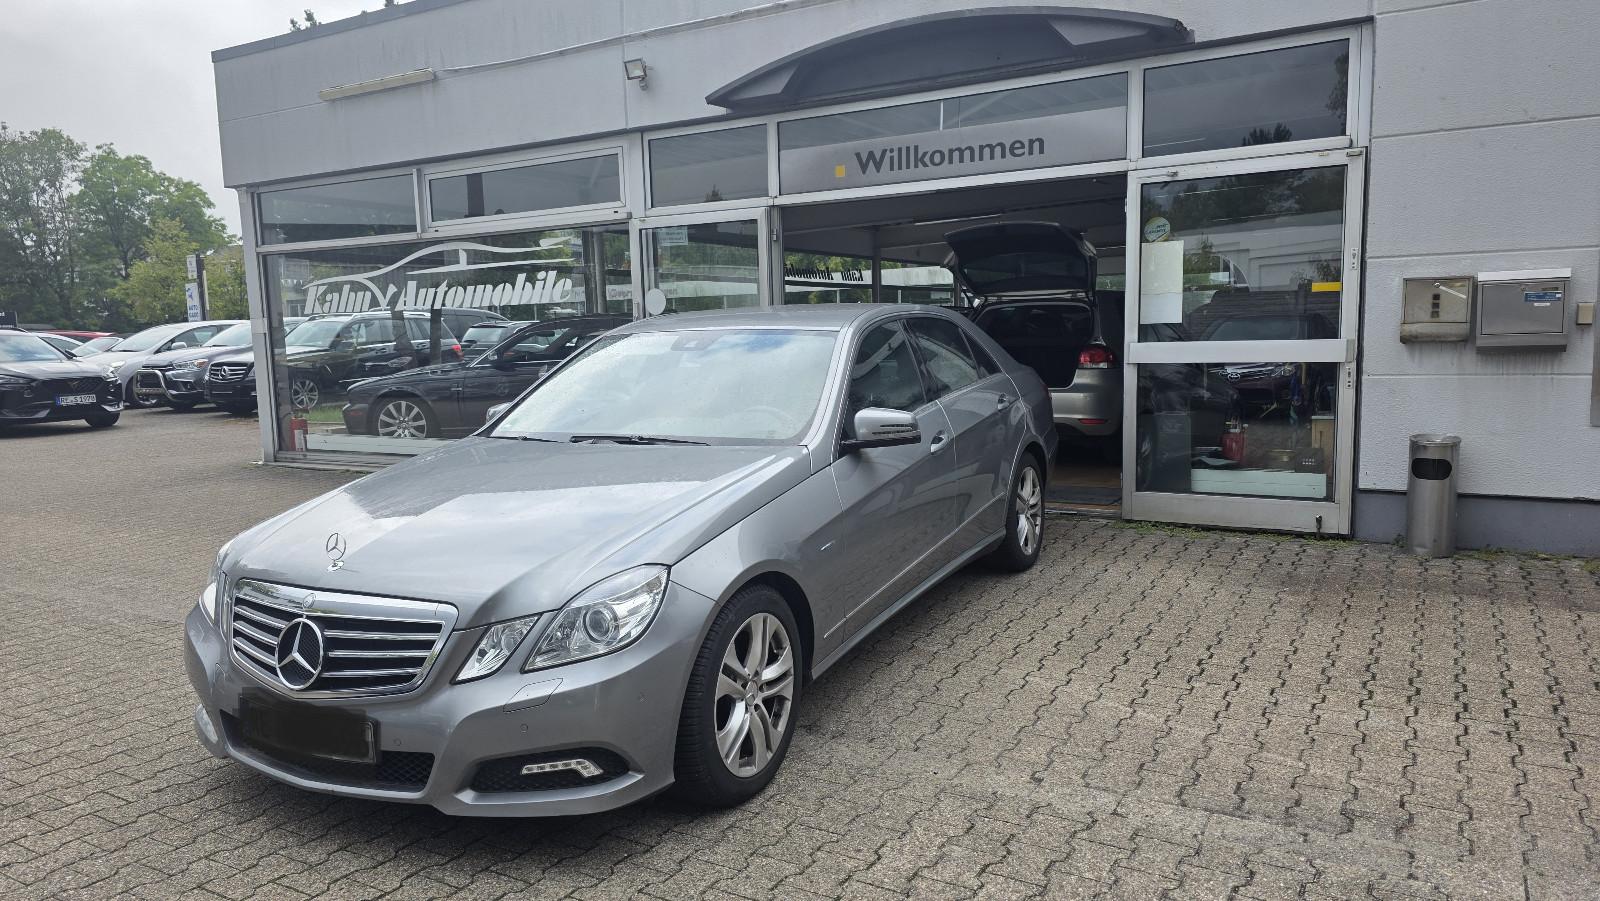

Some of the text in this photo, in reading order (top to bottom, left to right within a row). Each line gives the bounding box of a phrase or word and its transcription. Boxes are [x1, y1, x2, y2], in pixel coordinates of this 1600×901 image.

[854, 136, 1045, 175] Willkommen
[304, 270, 573, 315] Kahn Automobile
